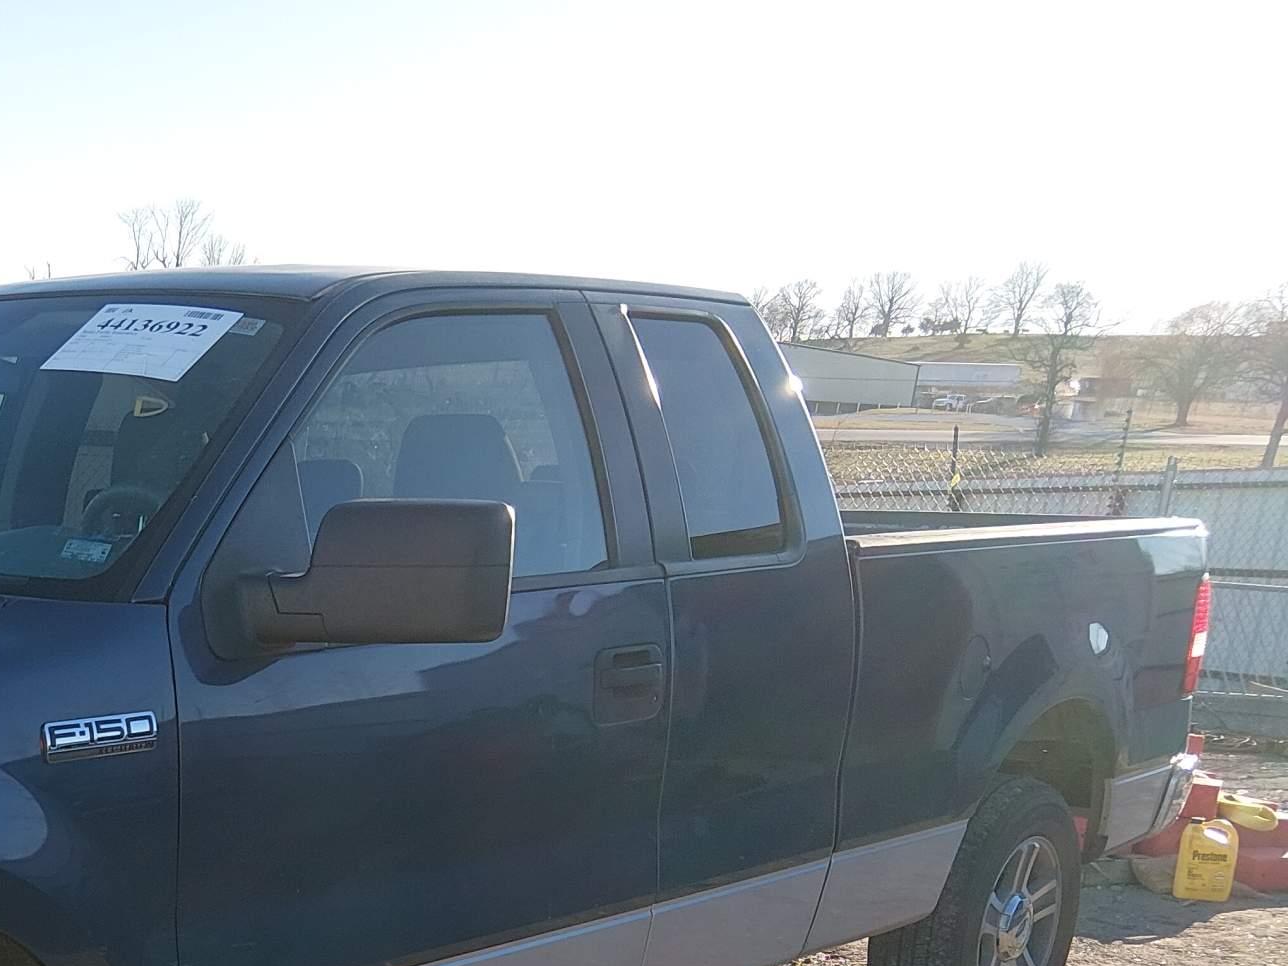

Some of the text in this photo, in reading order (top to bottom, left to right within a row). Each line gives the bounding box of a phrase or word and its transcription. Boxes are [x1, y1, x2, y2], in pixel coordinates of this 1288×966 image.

[97, 317, 208, 337] 44136922
[46, 713, 155, 748] F-150
[1192, 850, 1228, 862] Prestone
